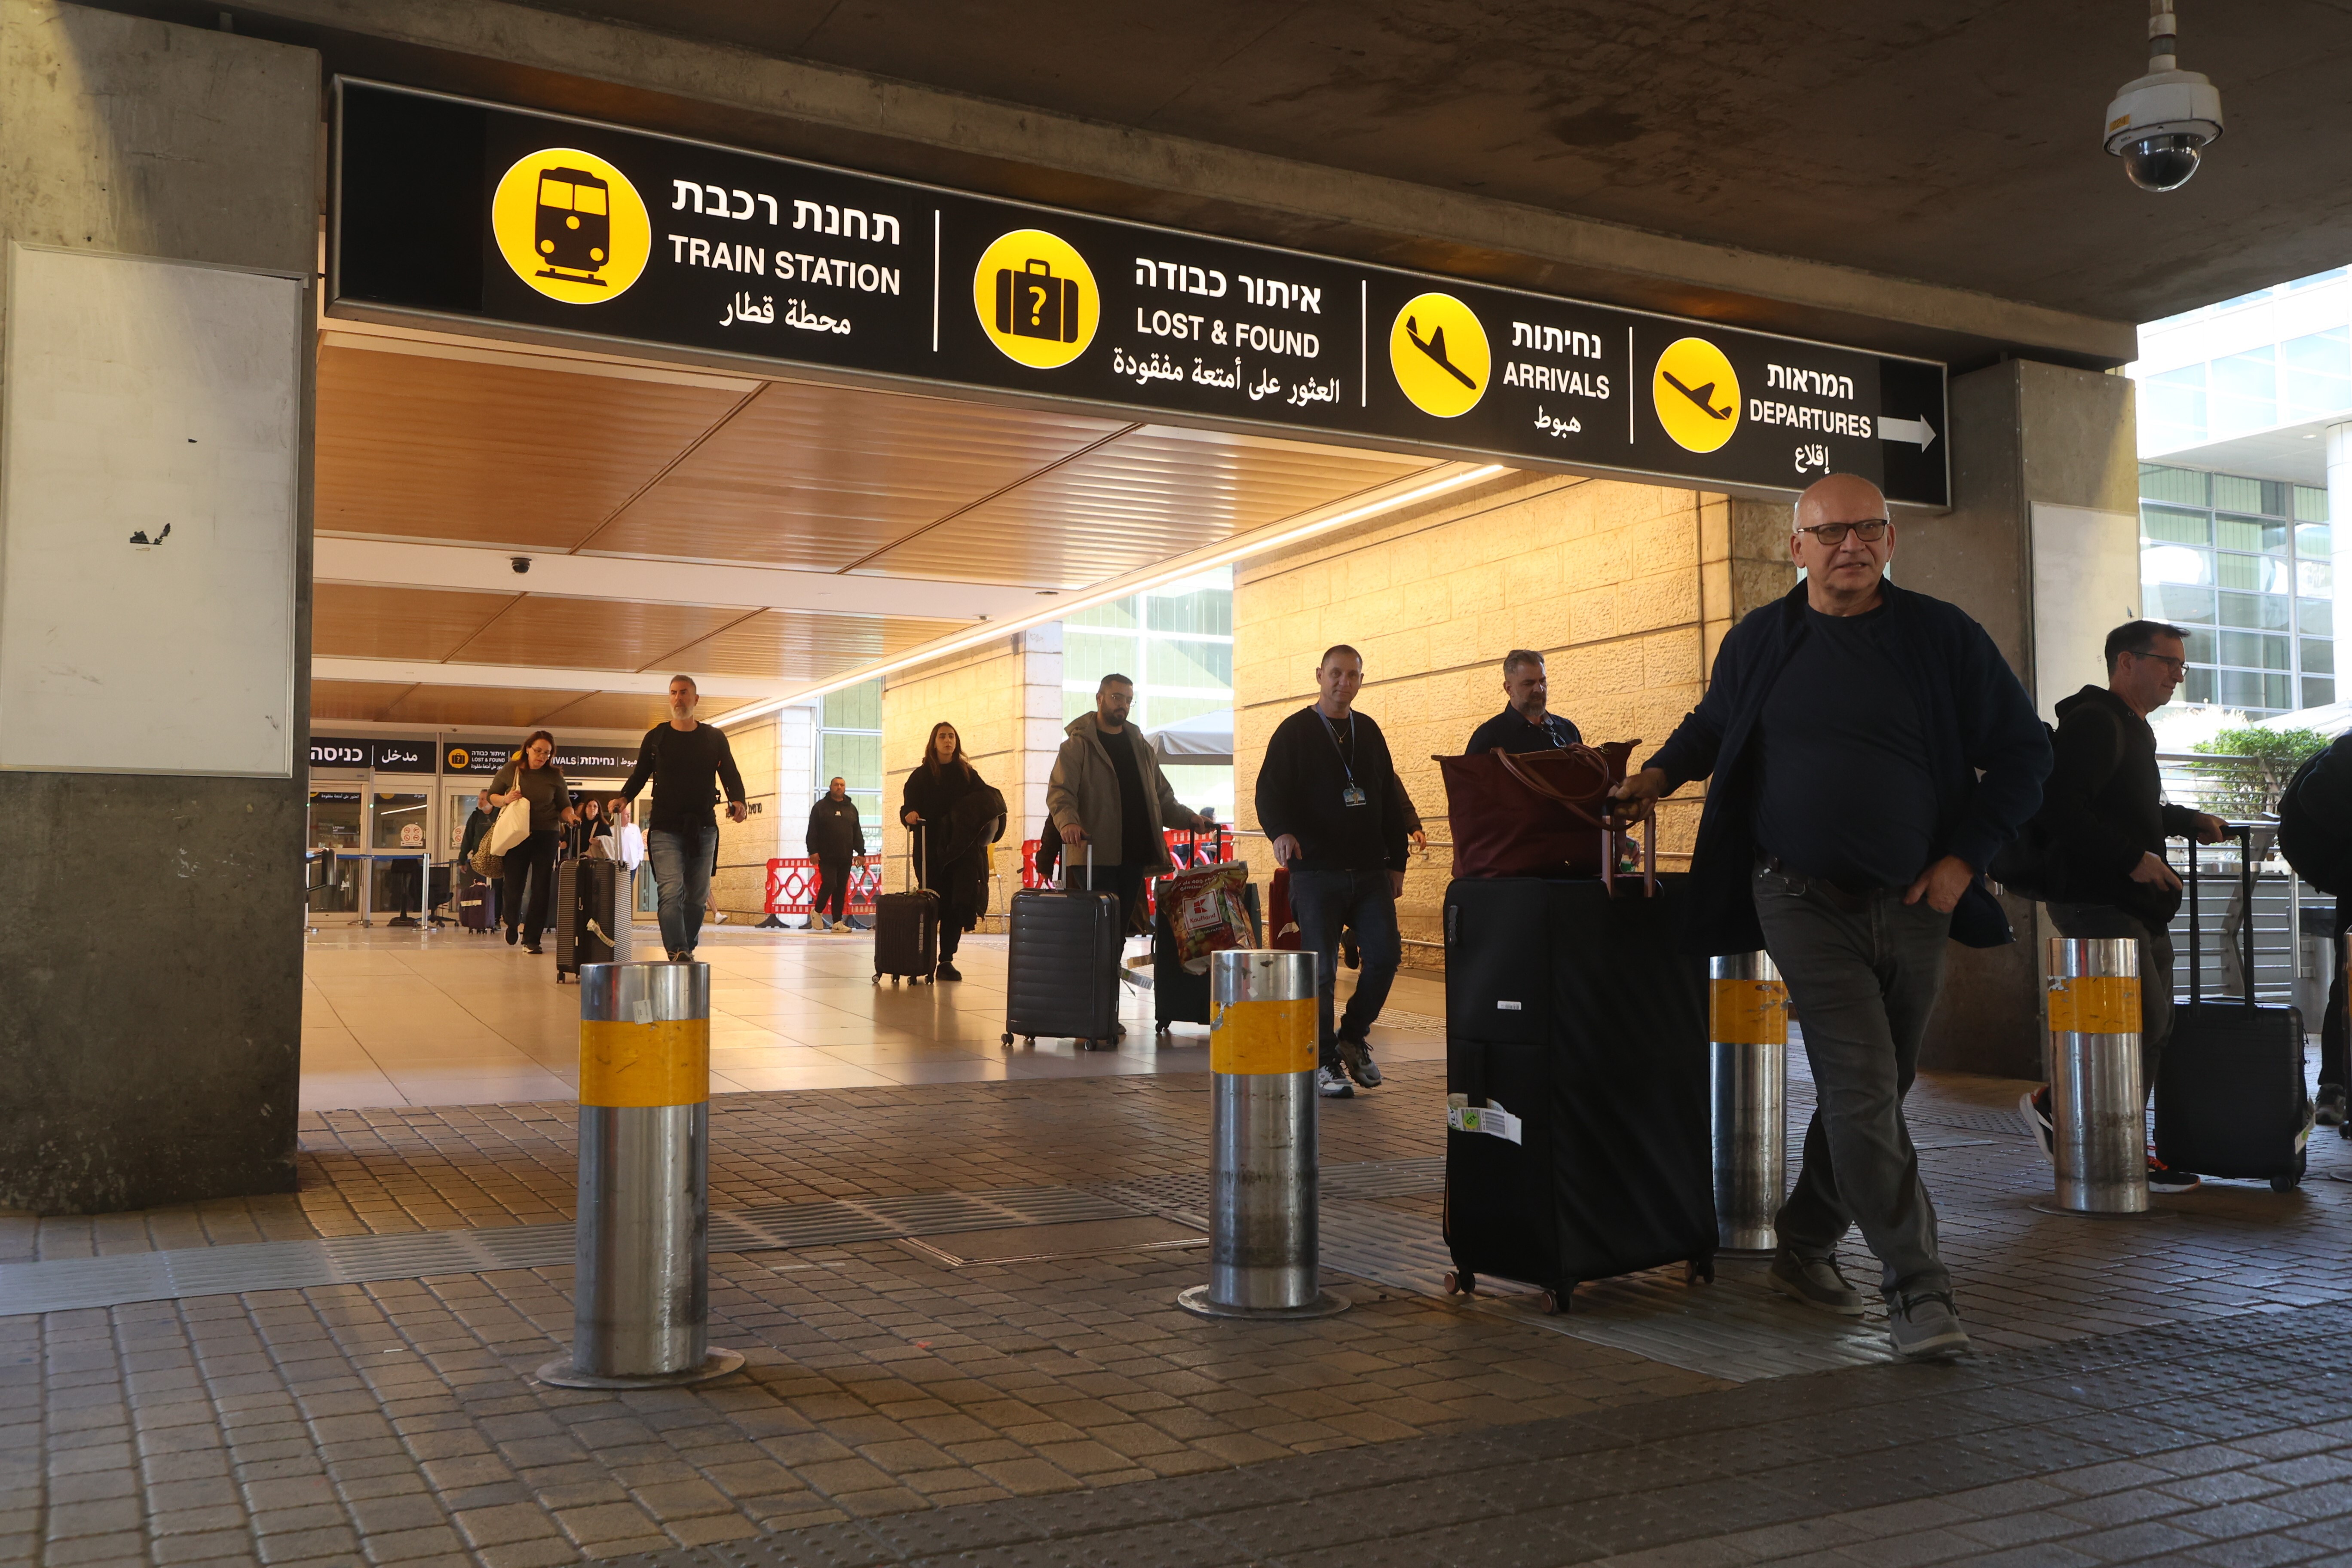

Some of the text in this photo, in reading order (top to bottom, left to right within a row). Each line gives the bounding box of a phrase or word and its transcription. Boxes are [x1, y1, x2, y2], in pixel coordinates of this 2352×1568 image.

[672, 179, 900, 245] תחנת רכבת
[668, 234, 900, 295] TRAIN STATION
[1136, 257, 1321, 314] איתור כבודה
[719, 291, 851, 335] محطة قطار
[1137, 307, 1319, 358] LOST & FOUND
[1512, 322, 1601, 359] נחיתות
[1113, 347, 1340, 407] العثور على أمتعة مفقودة
[1503, 361, 1610, 399] ARRIVALS
[1767, 364, 1853, 400] המראות
[1534, 405, 1581, 439] هبوط
[1750, 399, 1871, 438] DEPARTURES
[1795, 444, 1830, 475] إقلاع
[310, 747, 363, 761] כניסה
[381, 749, 418, 763] مدخل
[553, 756, 576, 765] IVALS
[580, 756, 615, 766] נחיתות
[1189, 913, 1216, 924] Kaufland
[1466, 1114, 1477, 1124] CTX
